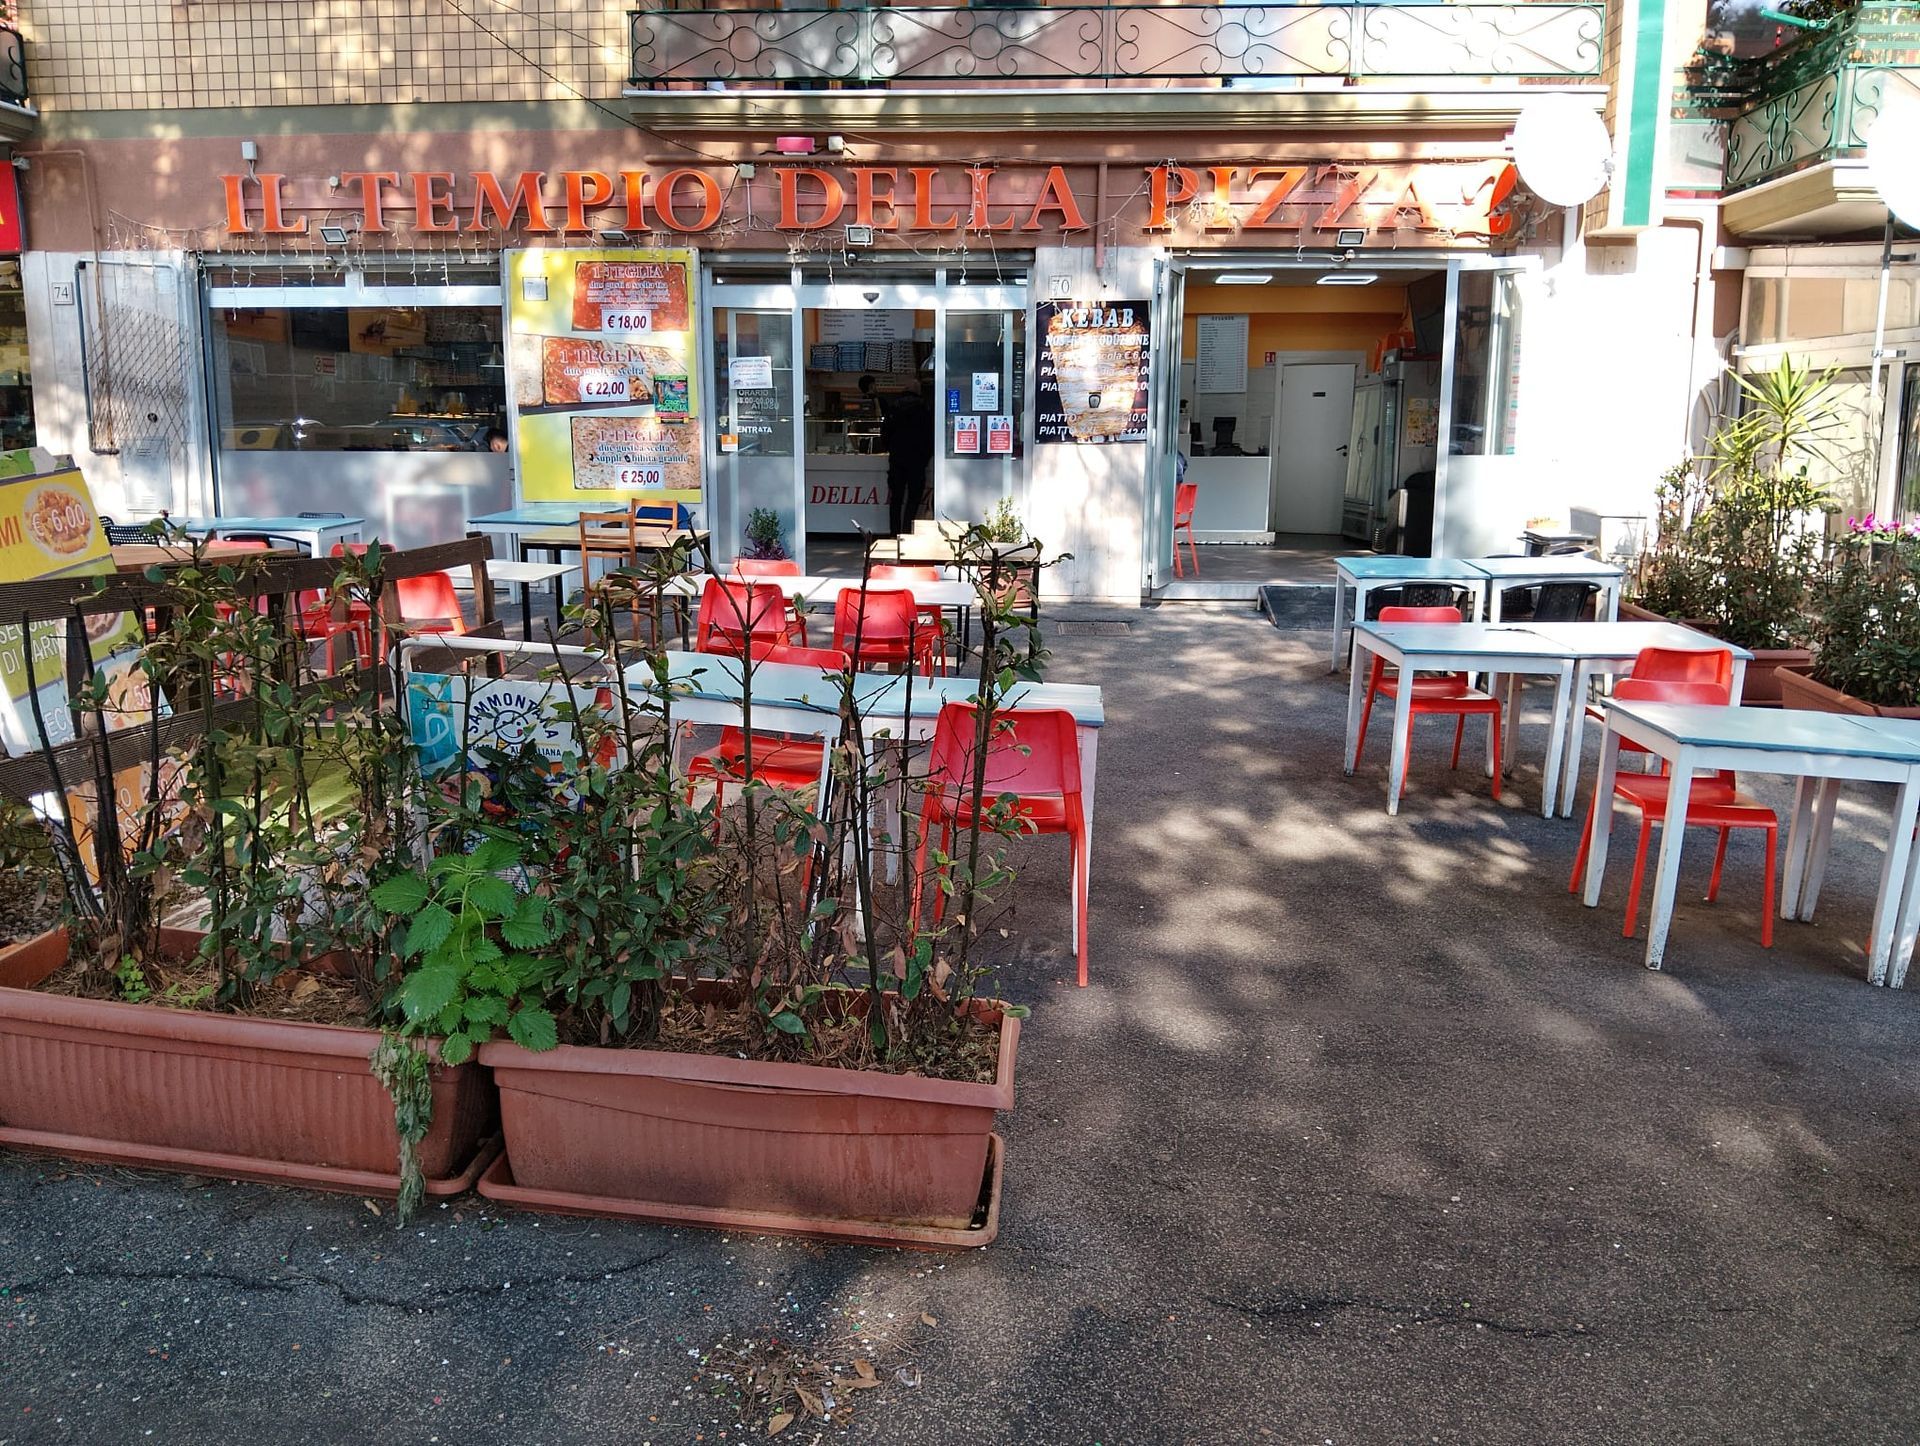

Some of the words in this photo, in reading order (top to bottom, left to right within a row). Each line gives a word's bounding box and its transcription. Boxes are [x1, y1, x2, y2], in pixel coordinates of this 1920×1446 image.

[218, 174, 307, 234] IL
[342, 168, 724, 233] TEMPIO
[774, 166, 1091, 230] DELLA
[1142, 166, 1442, 230] PIZZA
[607, 265, 665, 279] TEGLIA
[54, 286, 69, 299] 74
[608, 315, 616, 328] €
[618, 315, 647, 330] 18,00
[1061, 308, 1134, 328] KEBAB
[575, 350, 646, 364] TEGLIA
[618, 366, 645, 375] scelta
[586, 383, 593, 395] €
[596, 382, 625, 397] 22,00
[739, 389, 769, 397] ORARIO
[1039, 413, 1077, 422] PIATTO
[610, 430, 677, 442] TEGLIA
[737, 425, 773, 434] ENTRATA
[1039, 426, 1075, 435] PIATTO
[621, 470, 628, 483] €
[631, 470, 660, 485] 25,00
[810, 486, 879, 505] DELLA
[32, 513, 45, 537] €
[51, 503, 86, 535] 6,00
[2, 651, 21, 676] DI
